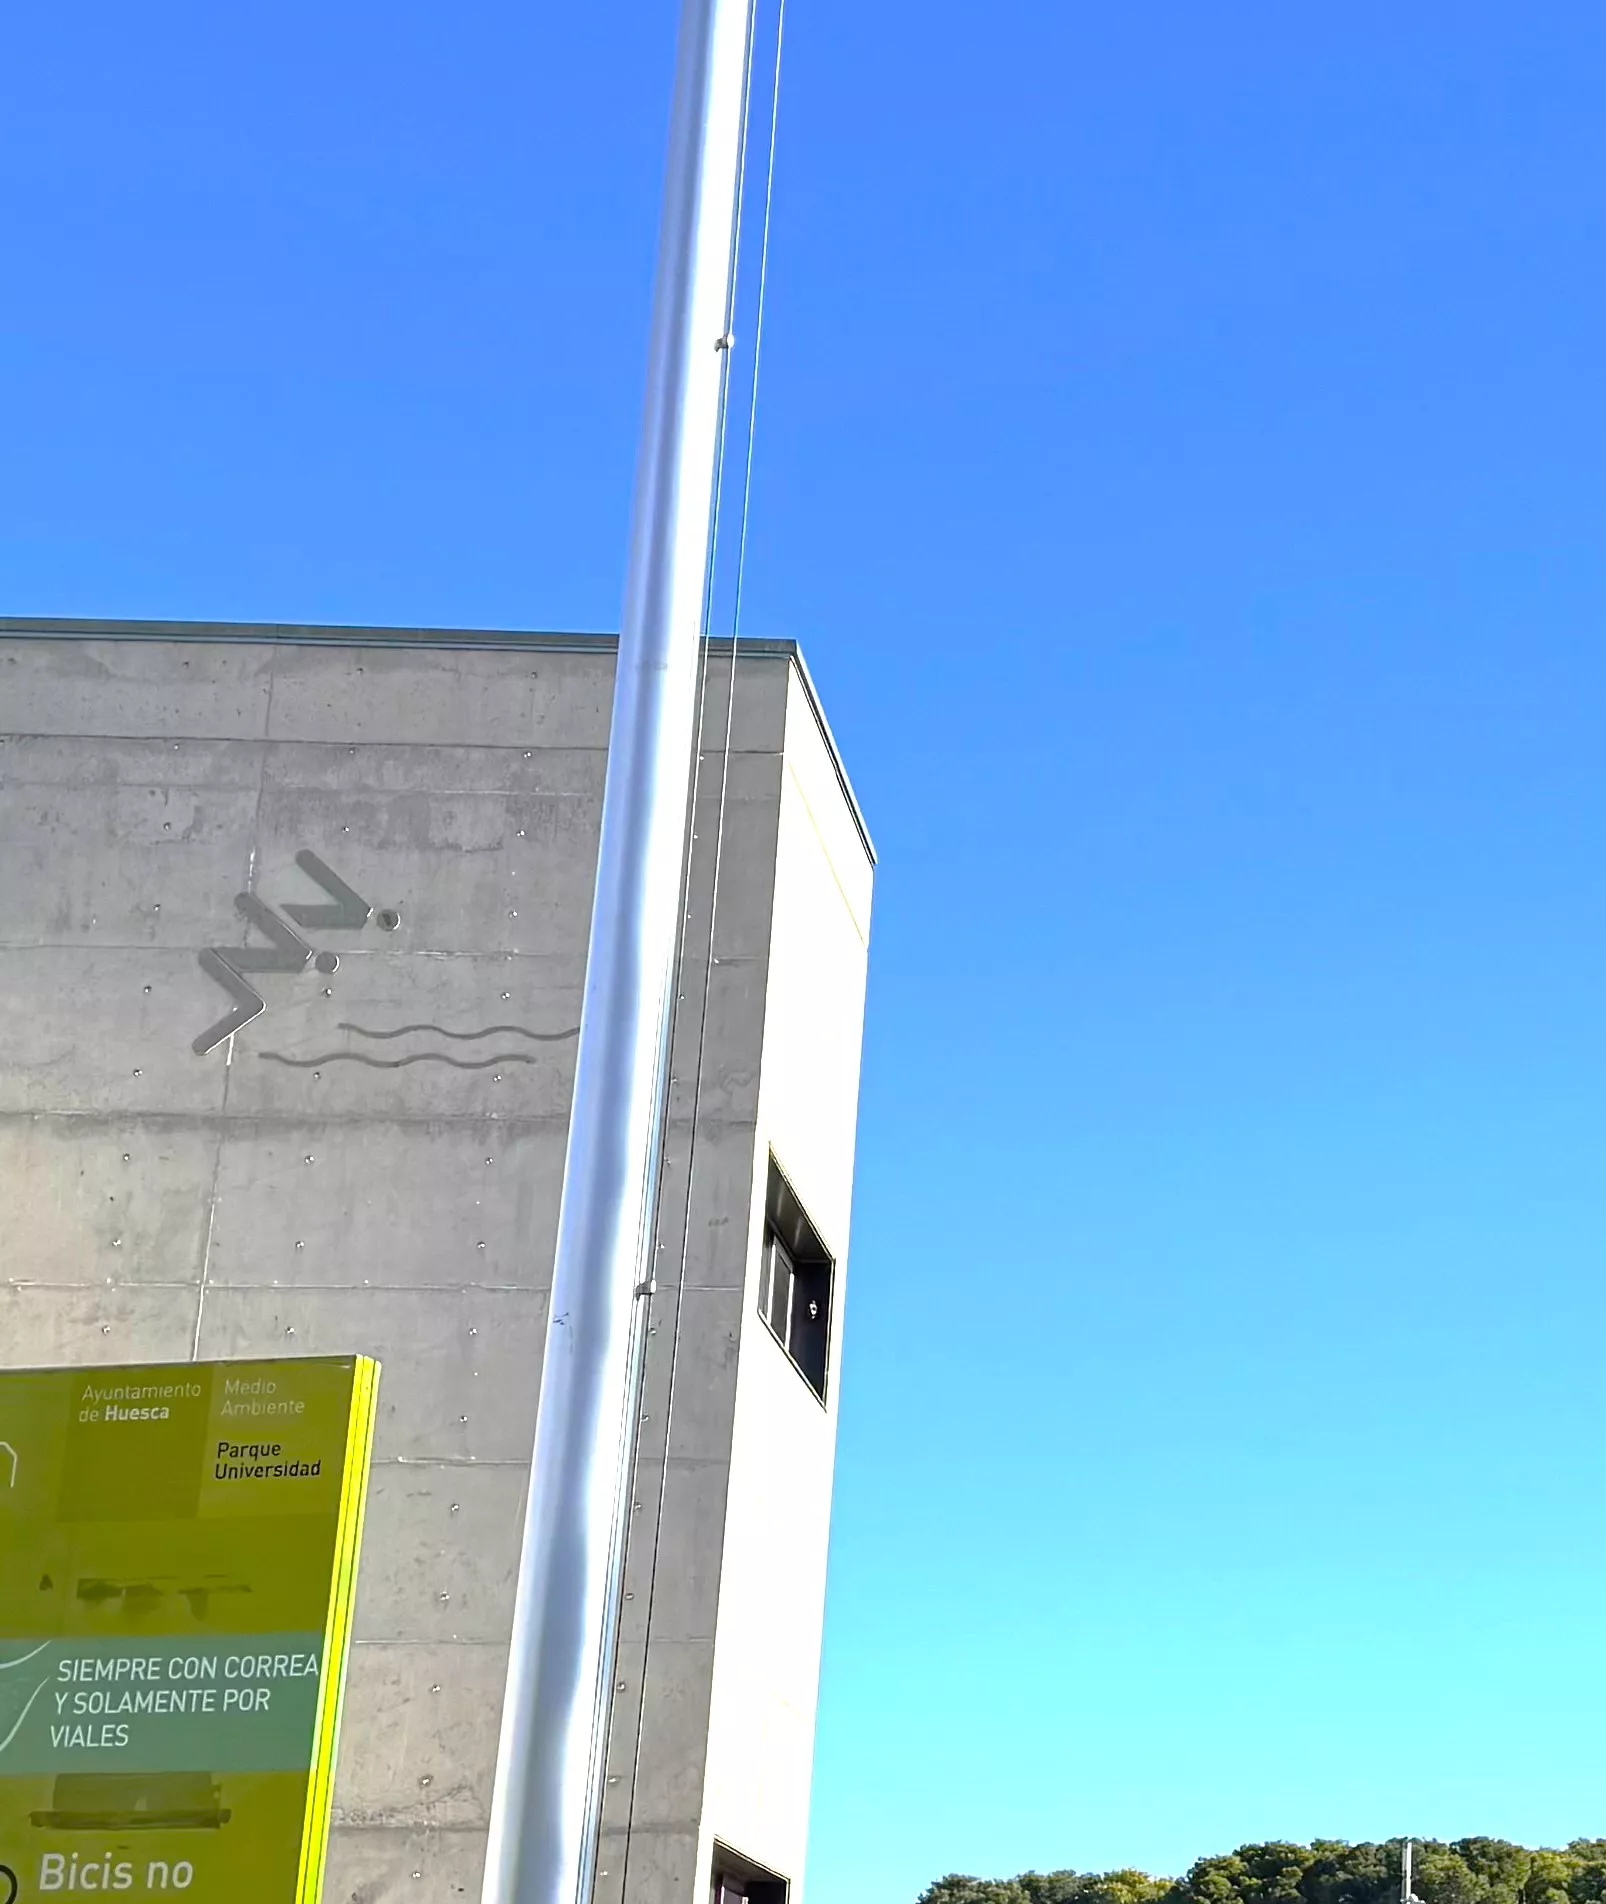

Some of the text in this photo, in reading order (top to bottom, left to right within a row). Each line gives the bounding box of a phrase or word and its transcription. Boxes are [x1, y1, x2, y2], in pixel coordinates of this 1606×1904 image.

[82, 1382, 201, 1404] Ayuntamiento
[224, 1379, 276, 1395] Medio
[79, 1405, 170, 1422] de Huesca
[221, 1400, 305, 1416] Ambiente
[217, 1442, 282, 1462] Parque
[215, 1459, 321, 1480] Universidad
[57, 1653, 319, 1682] SIEMPRE CON CORREA
[55, 1688, 271, 1715] Y SOLAMENTE POR
[50, 1724, 129, 1748] VIALES
[39, 1852, 194, 1891] Bicis no
